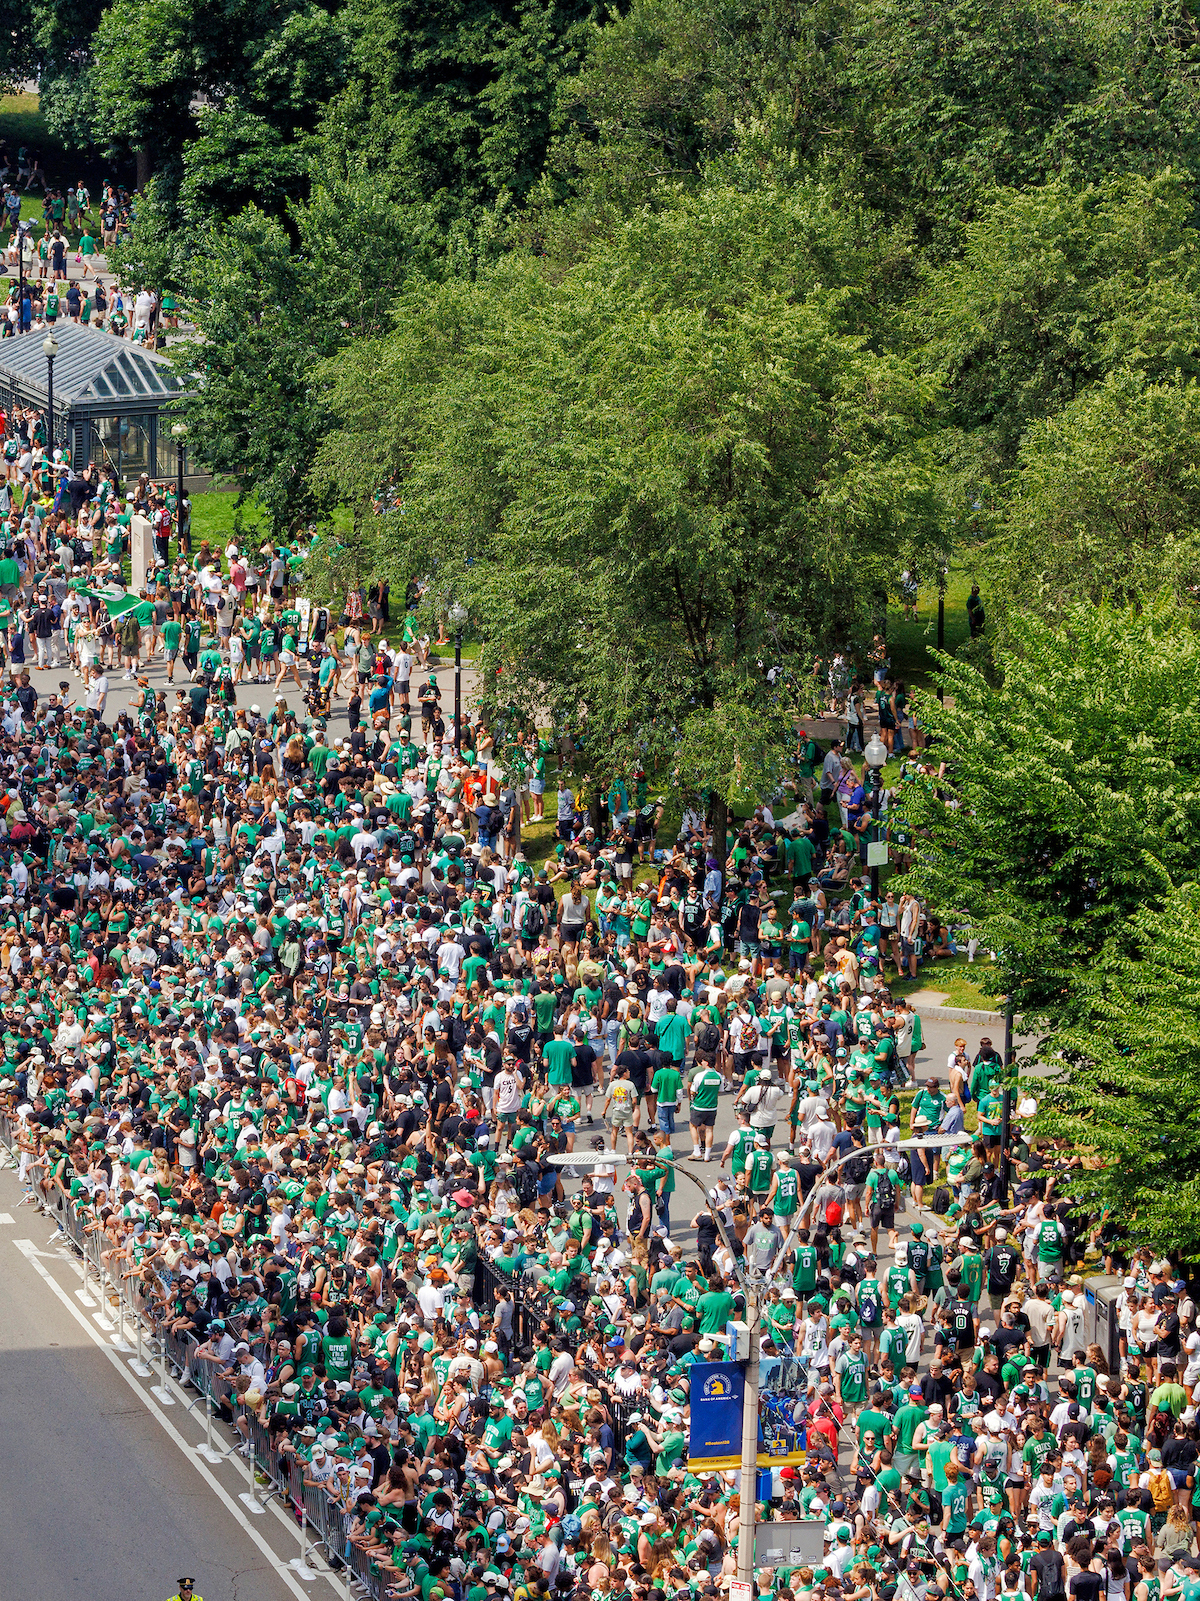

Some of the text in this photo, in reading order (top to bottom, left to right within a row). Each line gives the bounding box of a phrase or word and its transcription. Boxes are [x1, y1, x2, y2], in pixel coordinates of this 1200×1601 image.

[288, 615, 298, 623] 38
[760, 1161, 767, 1170] 5
[781, 1183, 795, 1196] 20
[1042, 1232, 1056, 1241] 33
[803, 1258, 810, 1267] 0
[913, 1256, 921, 1268] 9
[1000, 1260, 1009, 1274] 7
[894, 1280, 903, 1294] 4
[956, 1315, 966, 1329] 0
[1074, 1323, 1079, 1333] 7
[312, 1343, 317, 1353] 0
[896, 1340, 902, 1353] 0
[438, 1372, 444, 1385] 8
[854, 1373, 862, 1384] 0
[1081, 1384, 1091, 1398] 0
[1134, 1397, 1140, 1406] 0
[486, 1433, 492, 1444] 11
[1122, 1471, 1130, 1484] 0
[954, 1498, 964, 1514] 23
[1124, 1525, 1143, 1538] 42
